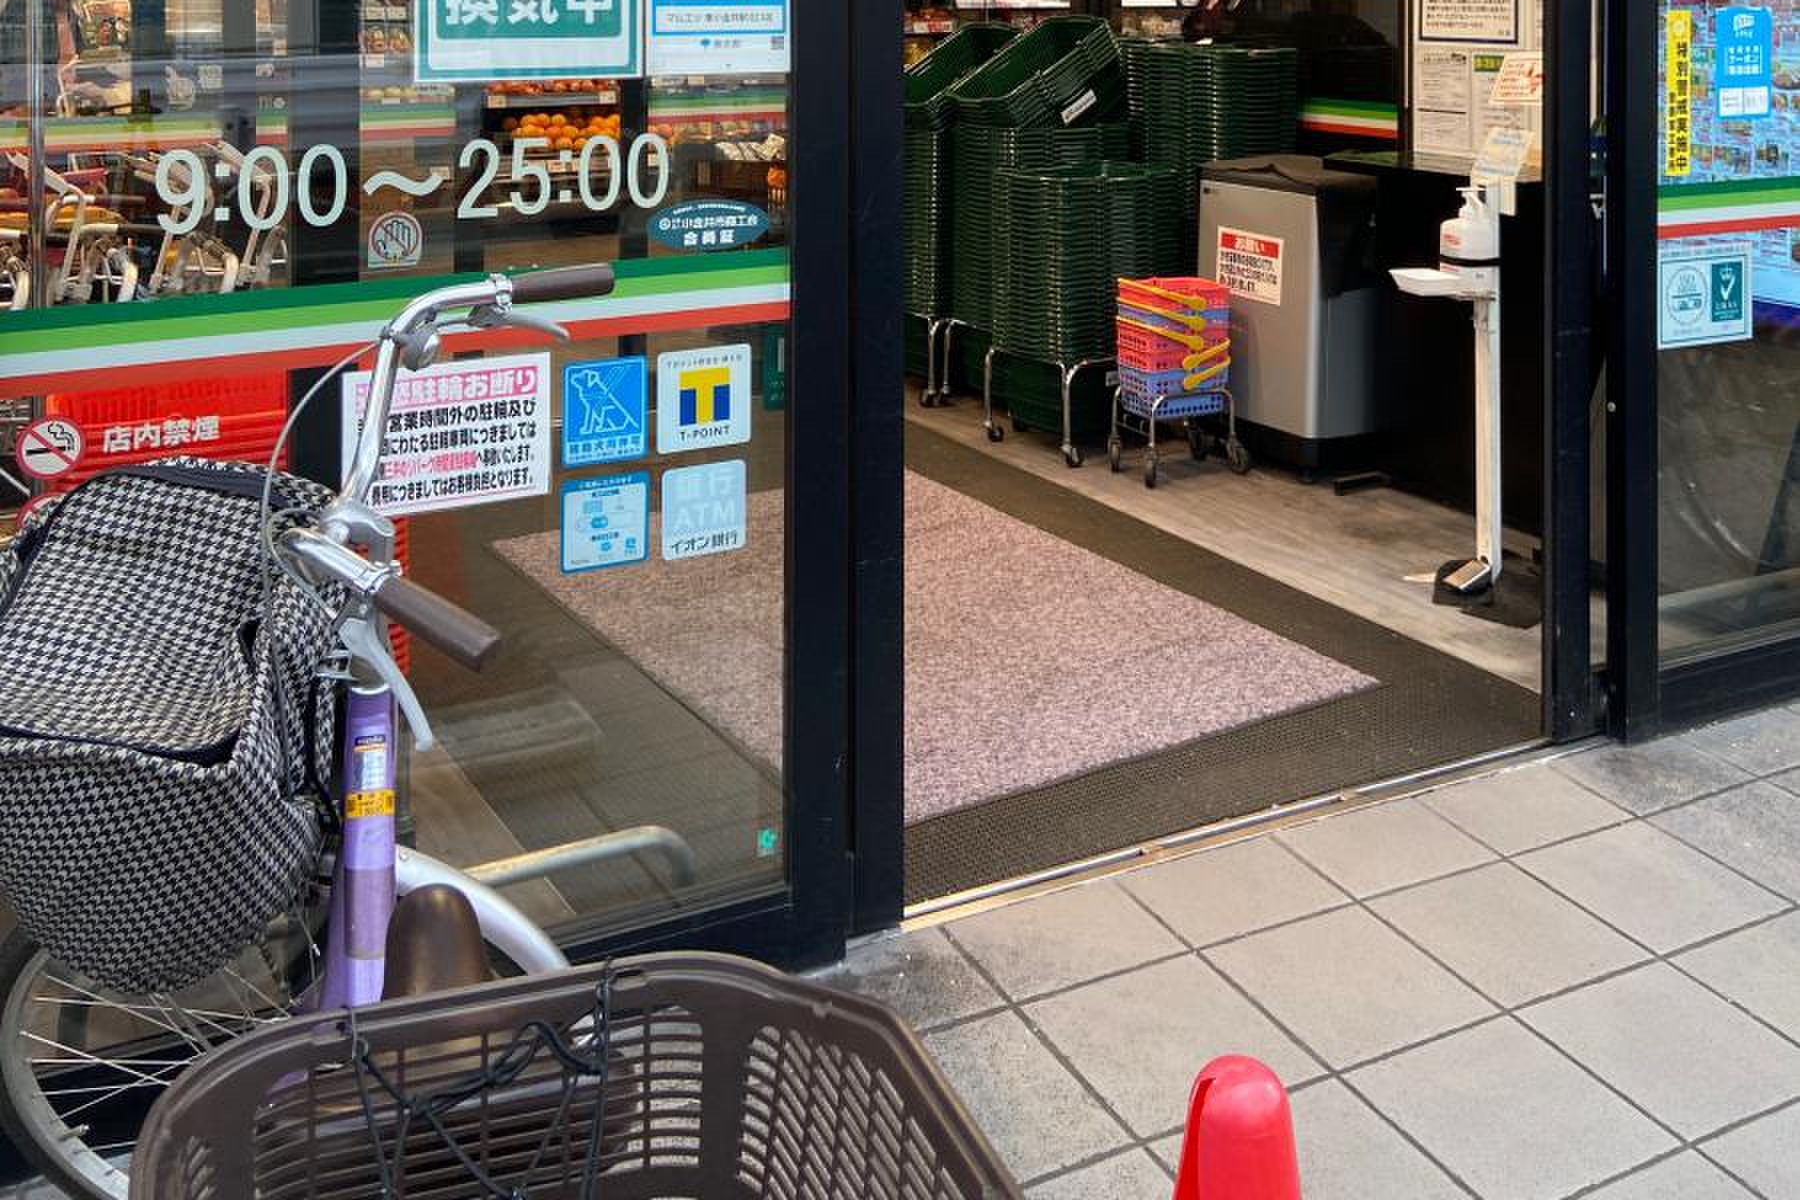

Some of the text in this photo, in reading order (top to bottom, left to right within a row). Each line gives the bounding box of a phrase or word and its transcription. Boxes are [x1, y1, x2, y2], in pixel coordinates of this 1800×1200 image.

[358, 399, 536, 437] 営業時間外の駐輪及び
[679, 424, 731, 442] T-POINT
[102, 415, 221, 453] 店内禁煙
[674, 500, 736, 530] ATM
[671, 530, 738, 555] イオン銀行
